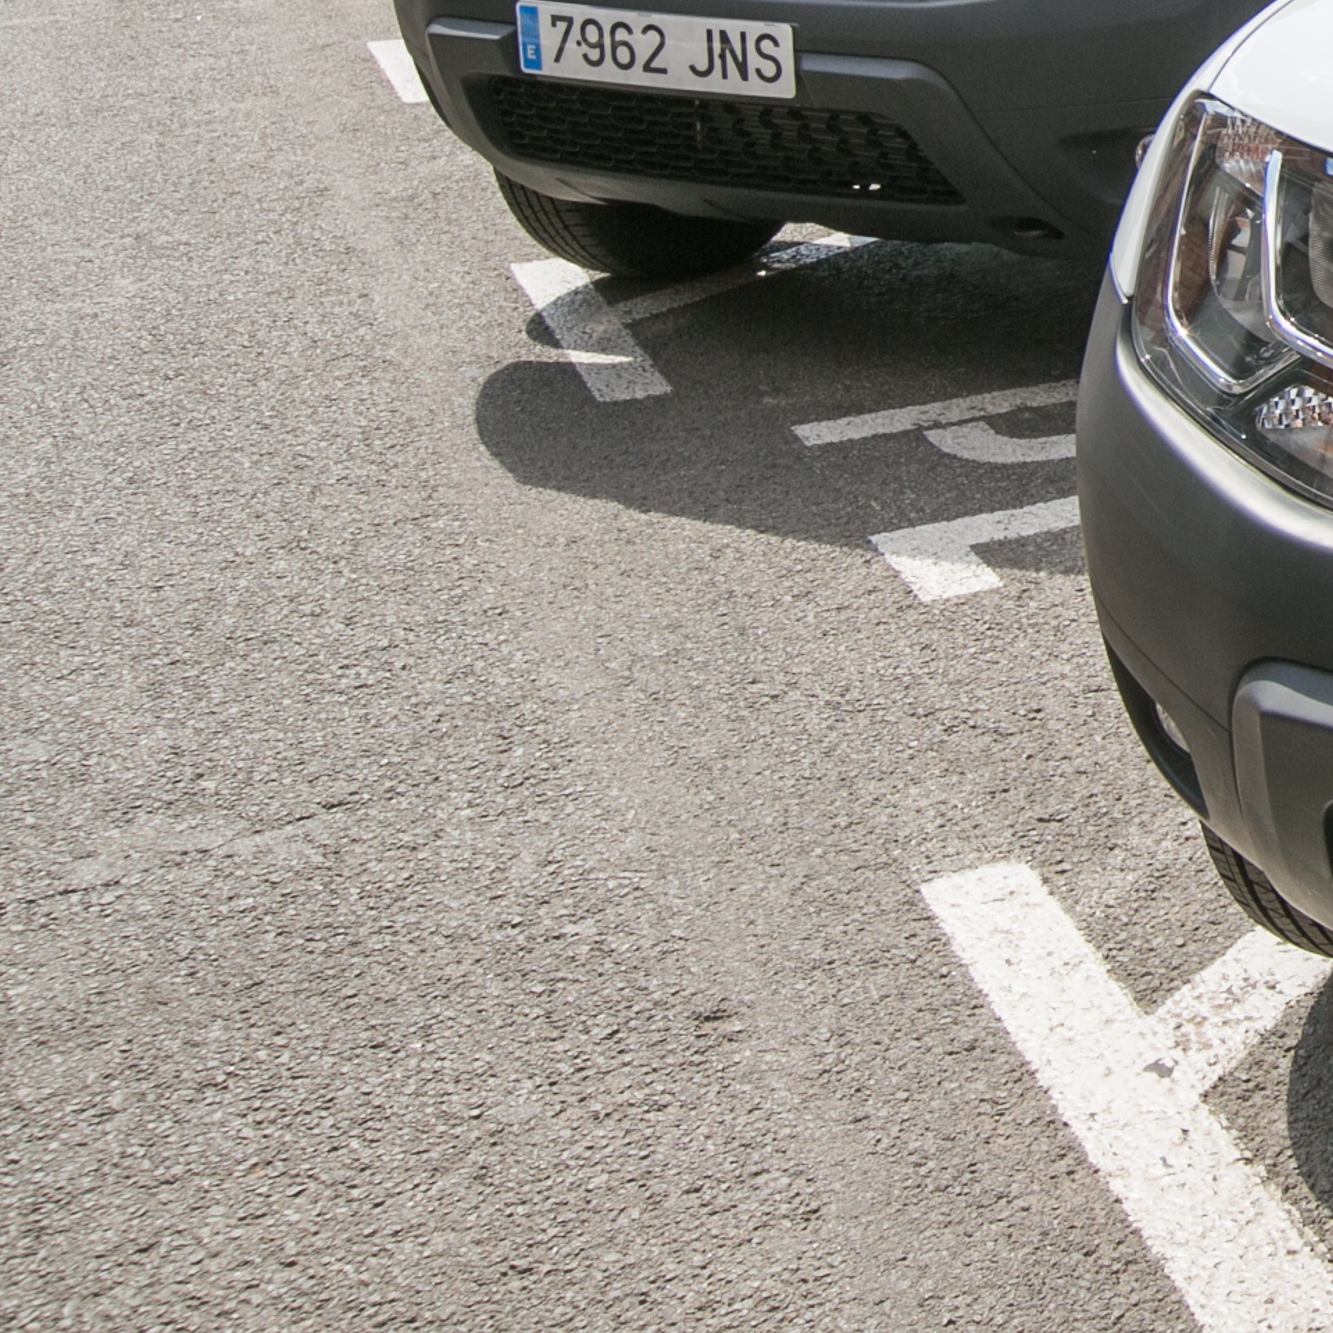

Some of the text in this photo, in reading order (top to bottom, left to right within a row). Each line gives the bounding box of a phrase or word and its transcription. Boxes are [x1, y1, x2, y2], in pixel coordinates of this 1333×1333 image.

[525, 14, 783, 83] E 7962 JNS
